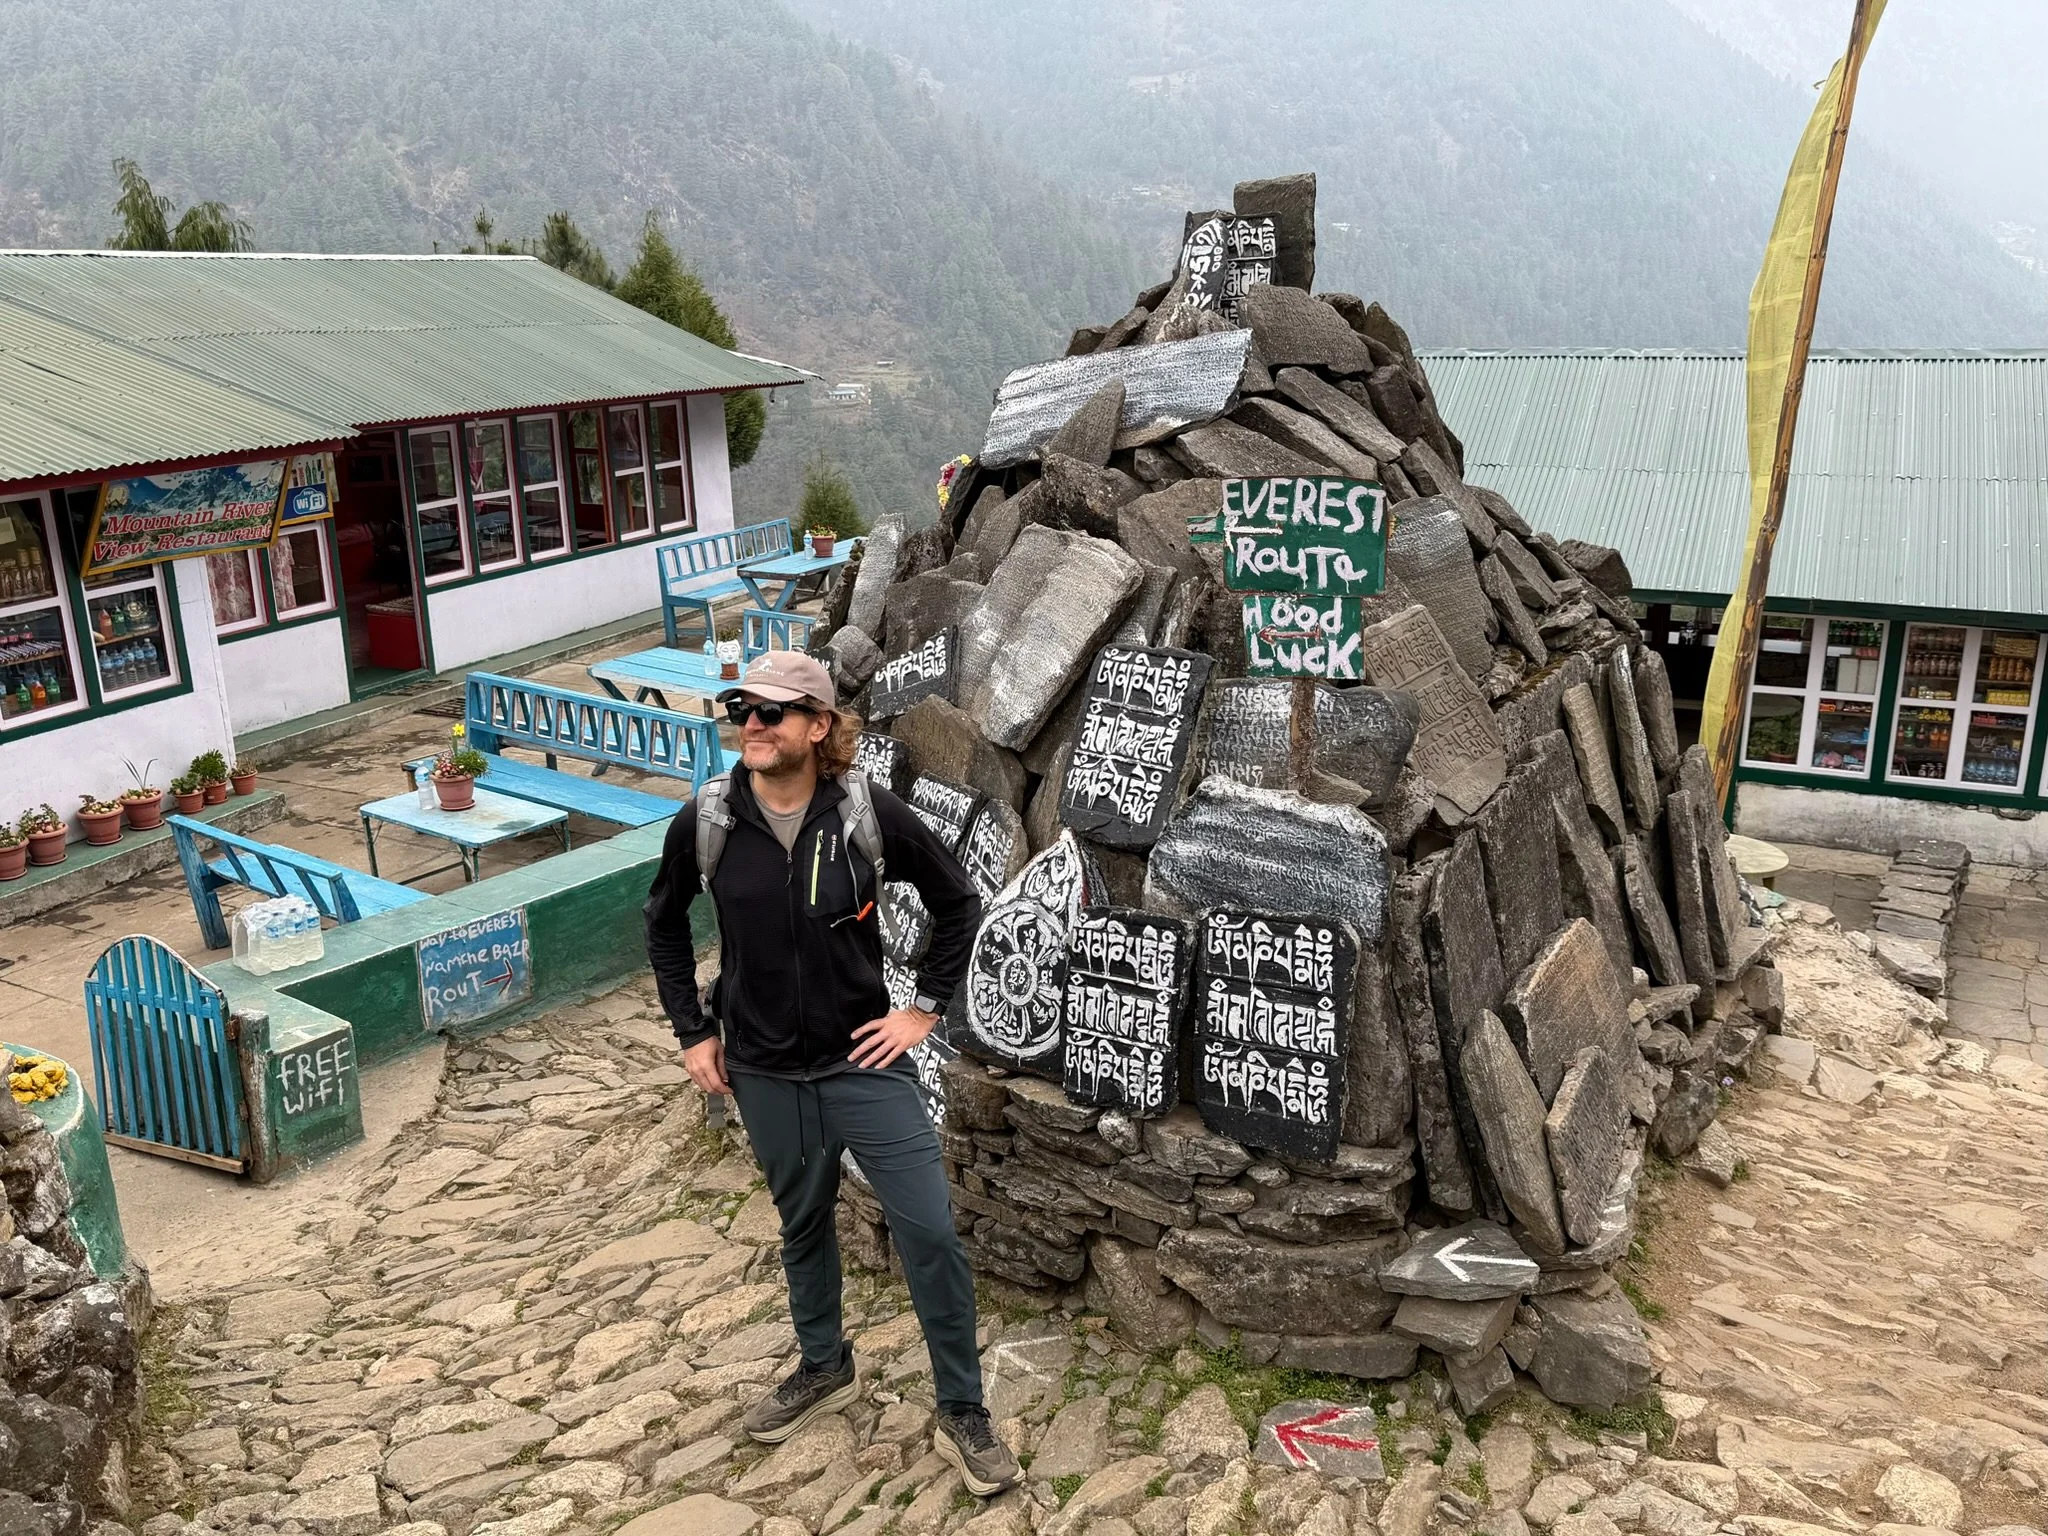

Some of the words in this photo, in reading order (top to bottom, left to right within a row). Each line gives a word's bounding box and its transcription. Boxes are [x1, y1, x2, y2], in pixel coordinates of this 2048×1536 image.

[103, 510, 214, 537] Mountain
[221, 498, 275, 521] River
[1221, 478, 1387, 534] EVEREST
[93, 539, 147, 562] View
[155, 522, 273, 551] Restaurant
[468, 909, 523, 940] EVEREST
[276, 1037, 352, 1091] FREE
